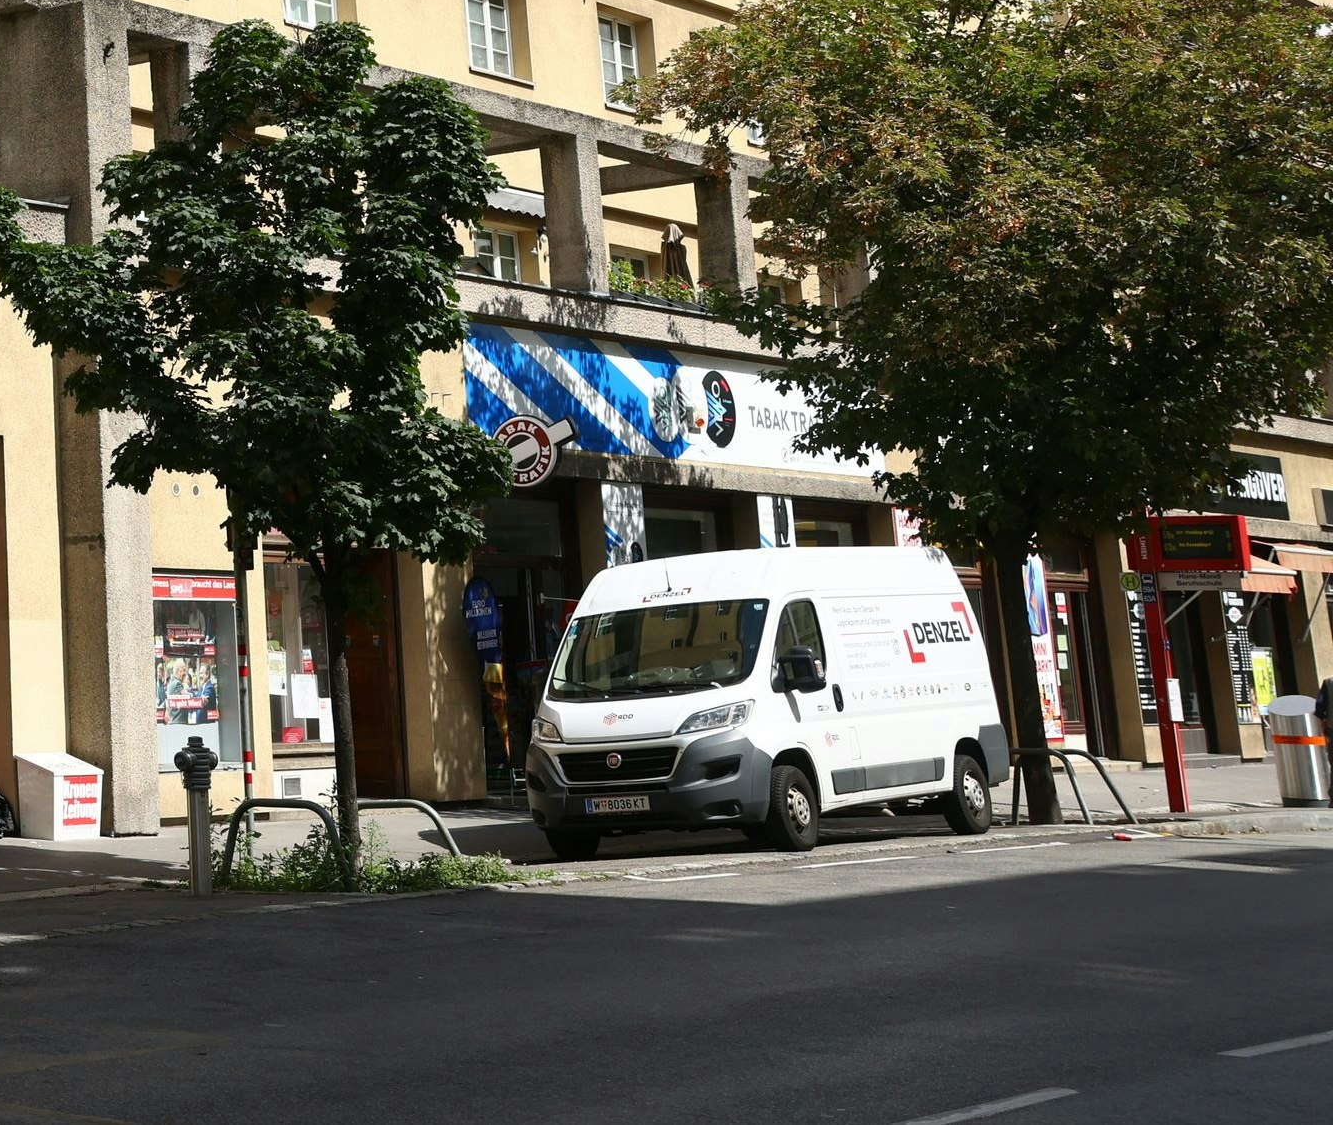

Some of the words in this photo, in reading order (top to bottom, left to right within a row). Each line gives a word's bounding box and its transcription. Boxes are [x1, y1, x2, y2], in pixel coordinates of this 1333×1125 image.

[748, 405, 790, 432] TABAK
[791, 411, 819, 433] TRA
[498, 421, 539, 446] ABAK
[1226, 470, 1287, 503] NGOVER
[1125, 576, 1135, 588] H
[649, 591, 686, 599] DENZEL
[471, 600, 486, 609] EURO
[912, 620, 971, 644] DENZEL
[1033, 642, 1047, 656] MINI
[1036, 660, 1052, 673] ARKT
[593, 800, 601, 811] W
